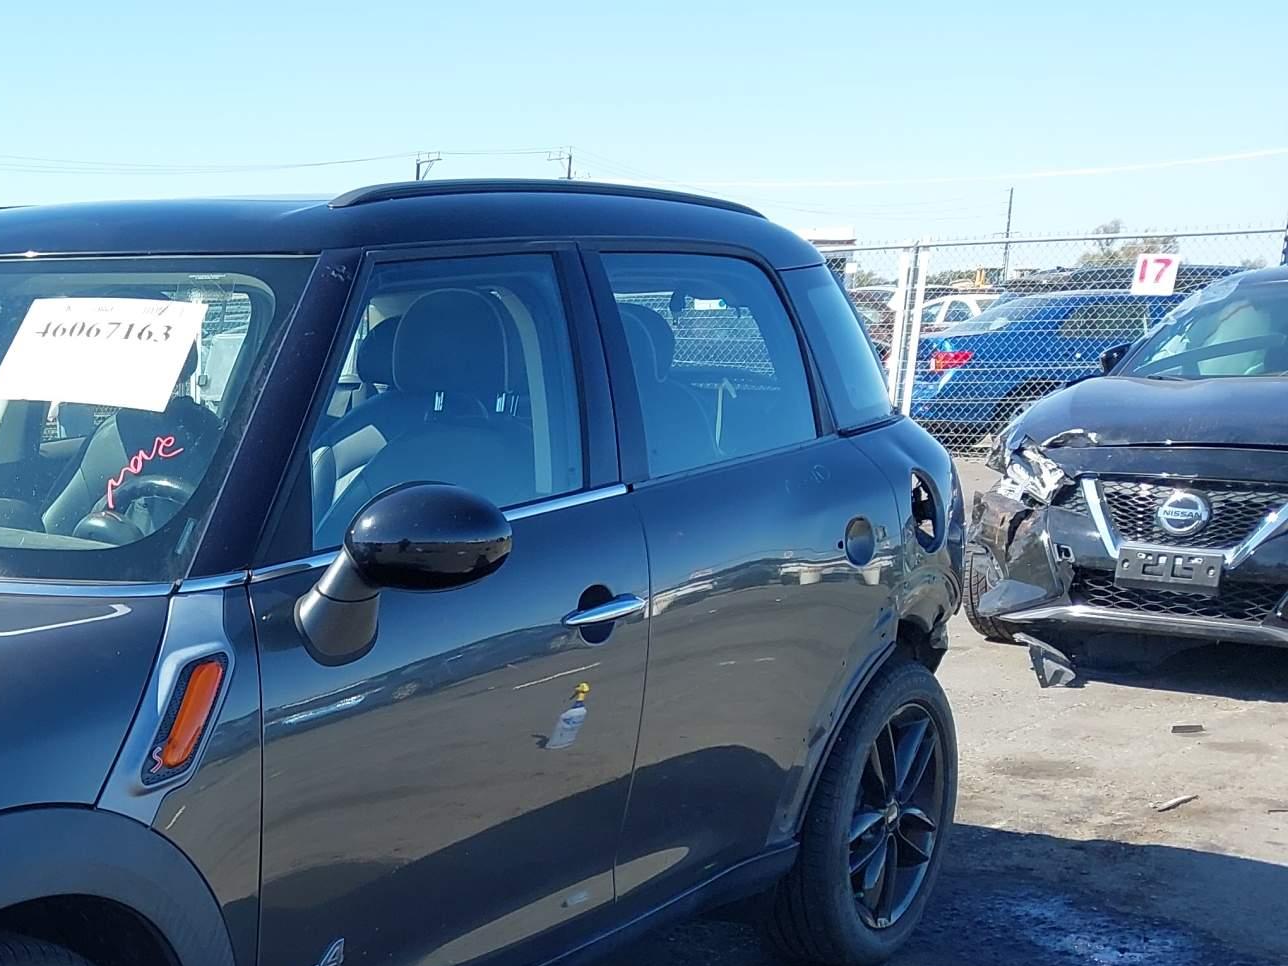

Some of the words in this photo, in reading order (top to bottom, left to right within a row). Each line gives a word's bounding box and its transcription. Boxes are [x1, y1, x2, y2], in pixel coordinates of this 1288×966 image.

[1139, 258, 1172, 283] 17
[35, 321, 173, 343] 46067163
[1163, 509, 1202, 521] NISSAN
